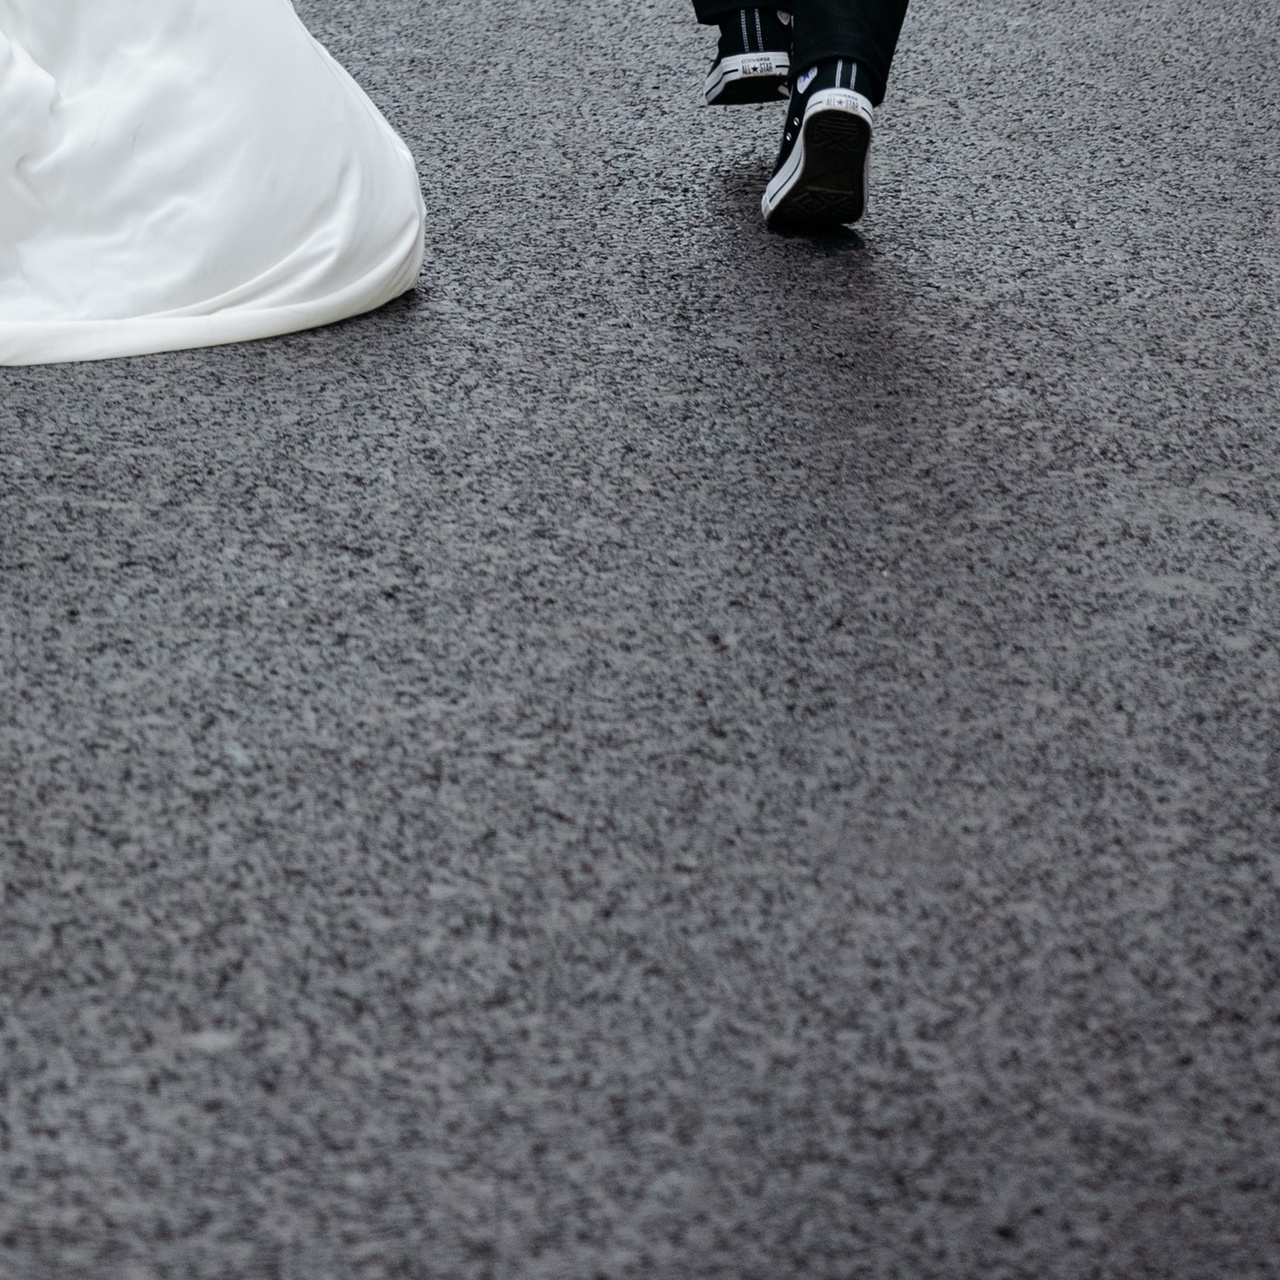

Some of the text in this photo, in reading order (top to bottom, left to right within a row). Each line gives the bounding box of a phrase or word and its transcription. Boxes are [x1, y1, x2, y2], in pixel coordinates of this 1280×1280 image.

[742, 62, 772, 75] ALL STAR
[826, 97, 859, 111] ALL STAR
